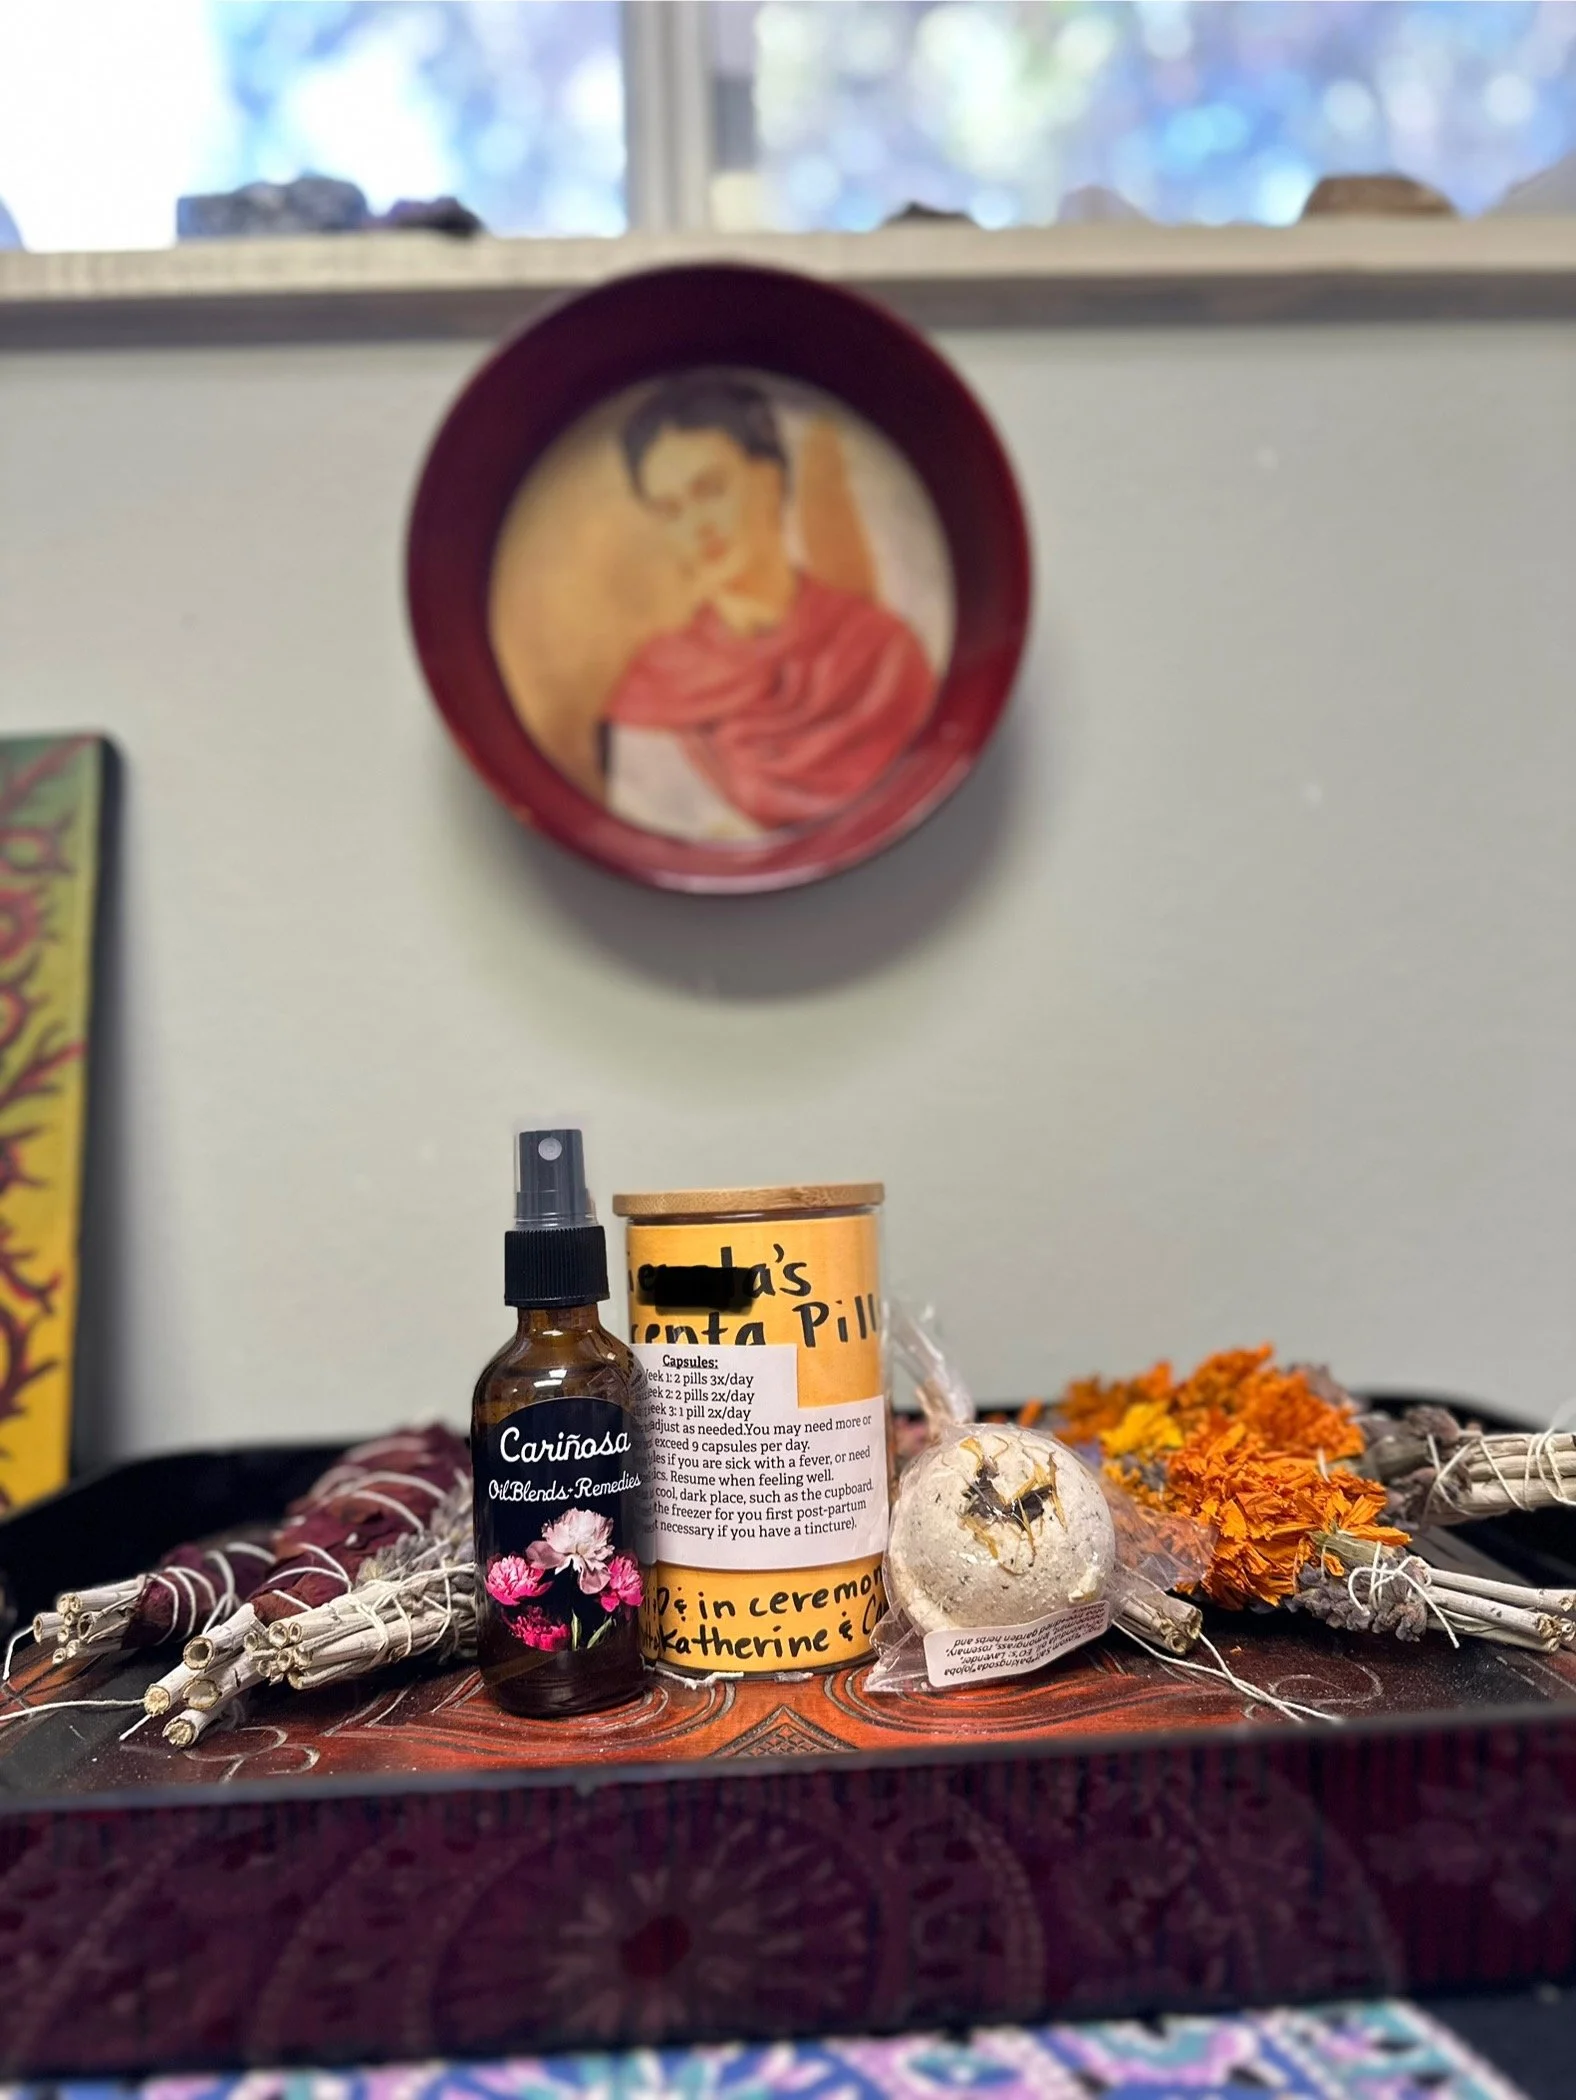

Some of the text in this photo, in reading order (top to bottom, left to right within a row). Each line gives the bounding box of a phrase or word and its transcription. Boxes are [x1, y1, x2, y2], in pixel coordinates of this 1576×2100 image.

[662, 1354, 719, 1370] Capsules:
[646, 1369, 754, 1388] eek 1: 2 pills 3x/day
[648, 1386, 755, 1404] eek 2: 2 pills 2x/day
[650, 1402, 751, 1421] eek 3: 1 pill 2x/day
[650, 1419, 680, 1434] adjust
[682, 1424, 695, 1435] as
[773, 1424, 801, 1436] may
[804, 1418, 833, 1433] need
[835, 1417, 861, 1430] more
[862, 1415, 871, 1425] or
[500, 1426, 632, 1463] Cariñosa
[654, 1437, 810, 1455] exceed 9 capsules per day.
[667, 1453, 677, 1465] if
[678, 1457, 699, 1469] you
[702, 1459, 722, 1469] are
[725, 1457, 751, 1469] sick
[755, 1456, 785, 1469] with
[788, 1459, 796, 1468] a
[799, 1454, 833, 1468] fever,
[834, 1454, 846, 1463] or
[848, 1445, 871, 1462] need
[670, 1470, 716, 1486] Resume
[718, 1474, 755, 1486] when
[758, 1473, 804, 1488] feeling
[806, 1469, 834, 1484] well.
[655, 1487, 678, 1500] cool,
[680, 1488, 707, 1502] dark
[710, 1491, 746, 1505] place,
[749, 1490, 781, 1504] such
[784, 1492, 798, 1502] as
[801, 1488, 822, 1501] the
[654, 1499, 867, 1523] the freezer for you first post-partum
[660, 1520, 714, 1539] necessary
[717, 1524, 728, 1537] if
[730, 1528, 755, 1540] you
[759, 1525, 791, 1537] have
[794, 1527, 801, 1536] a
[804, 1517, 857, 1535] tincture).
[699, 1591, 735, 1619] in
[953, 1638, 974, 1648] and
